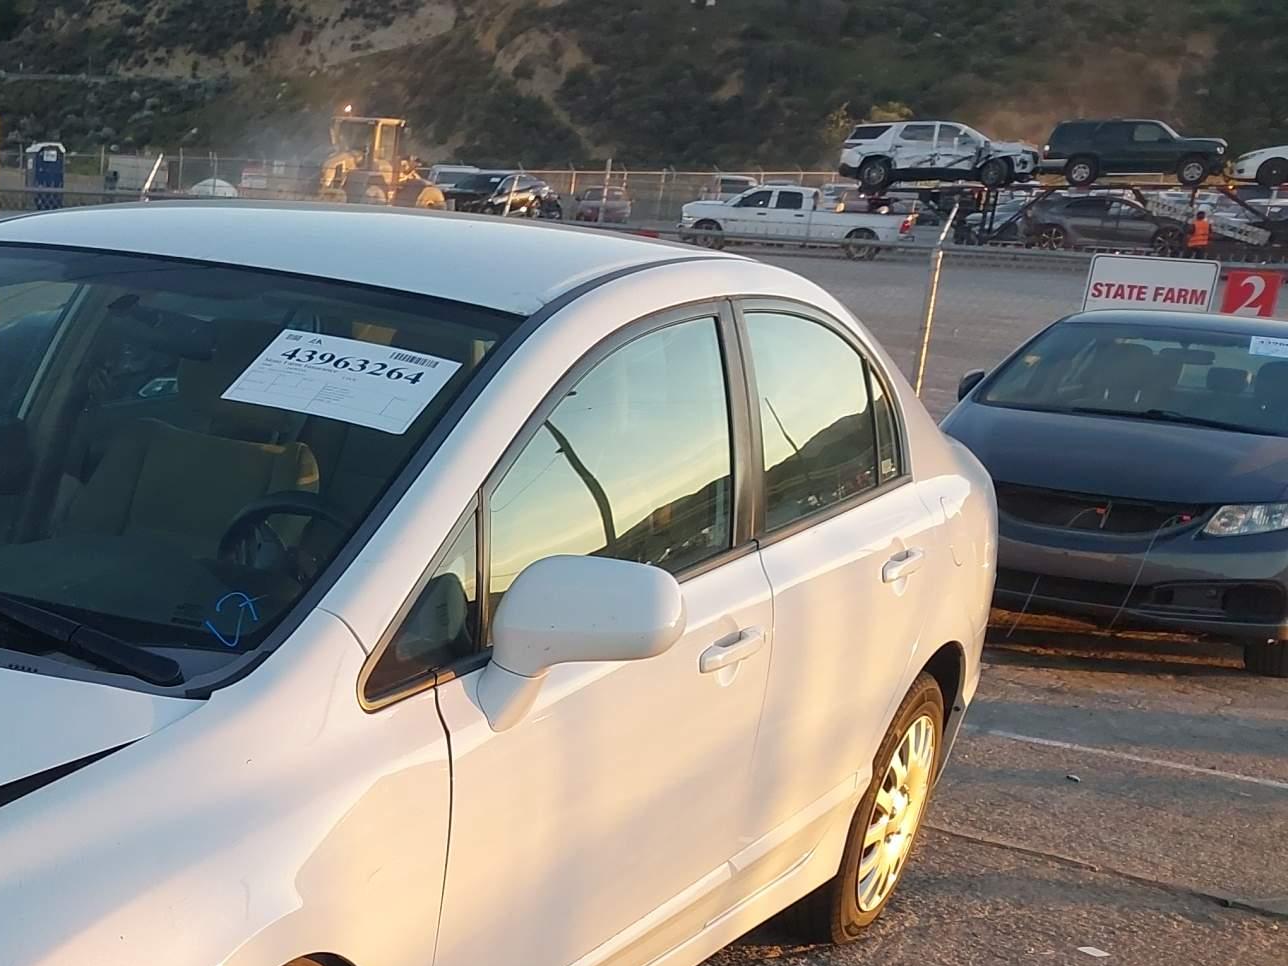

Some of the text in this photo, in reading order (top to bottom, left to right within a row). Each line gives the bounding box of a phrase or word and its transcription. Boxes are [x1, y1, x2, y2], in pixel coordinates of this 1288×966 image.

[1091, 282, 1208, 306] STATE FARM
[1233, 275, 1266, 317] 2
[281, 347, 425, 385] 43963264
